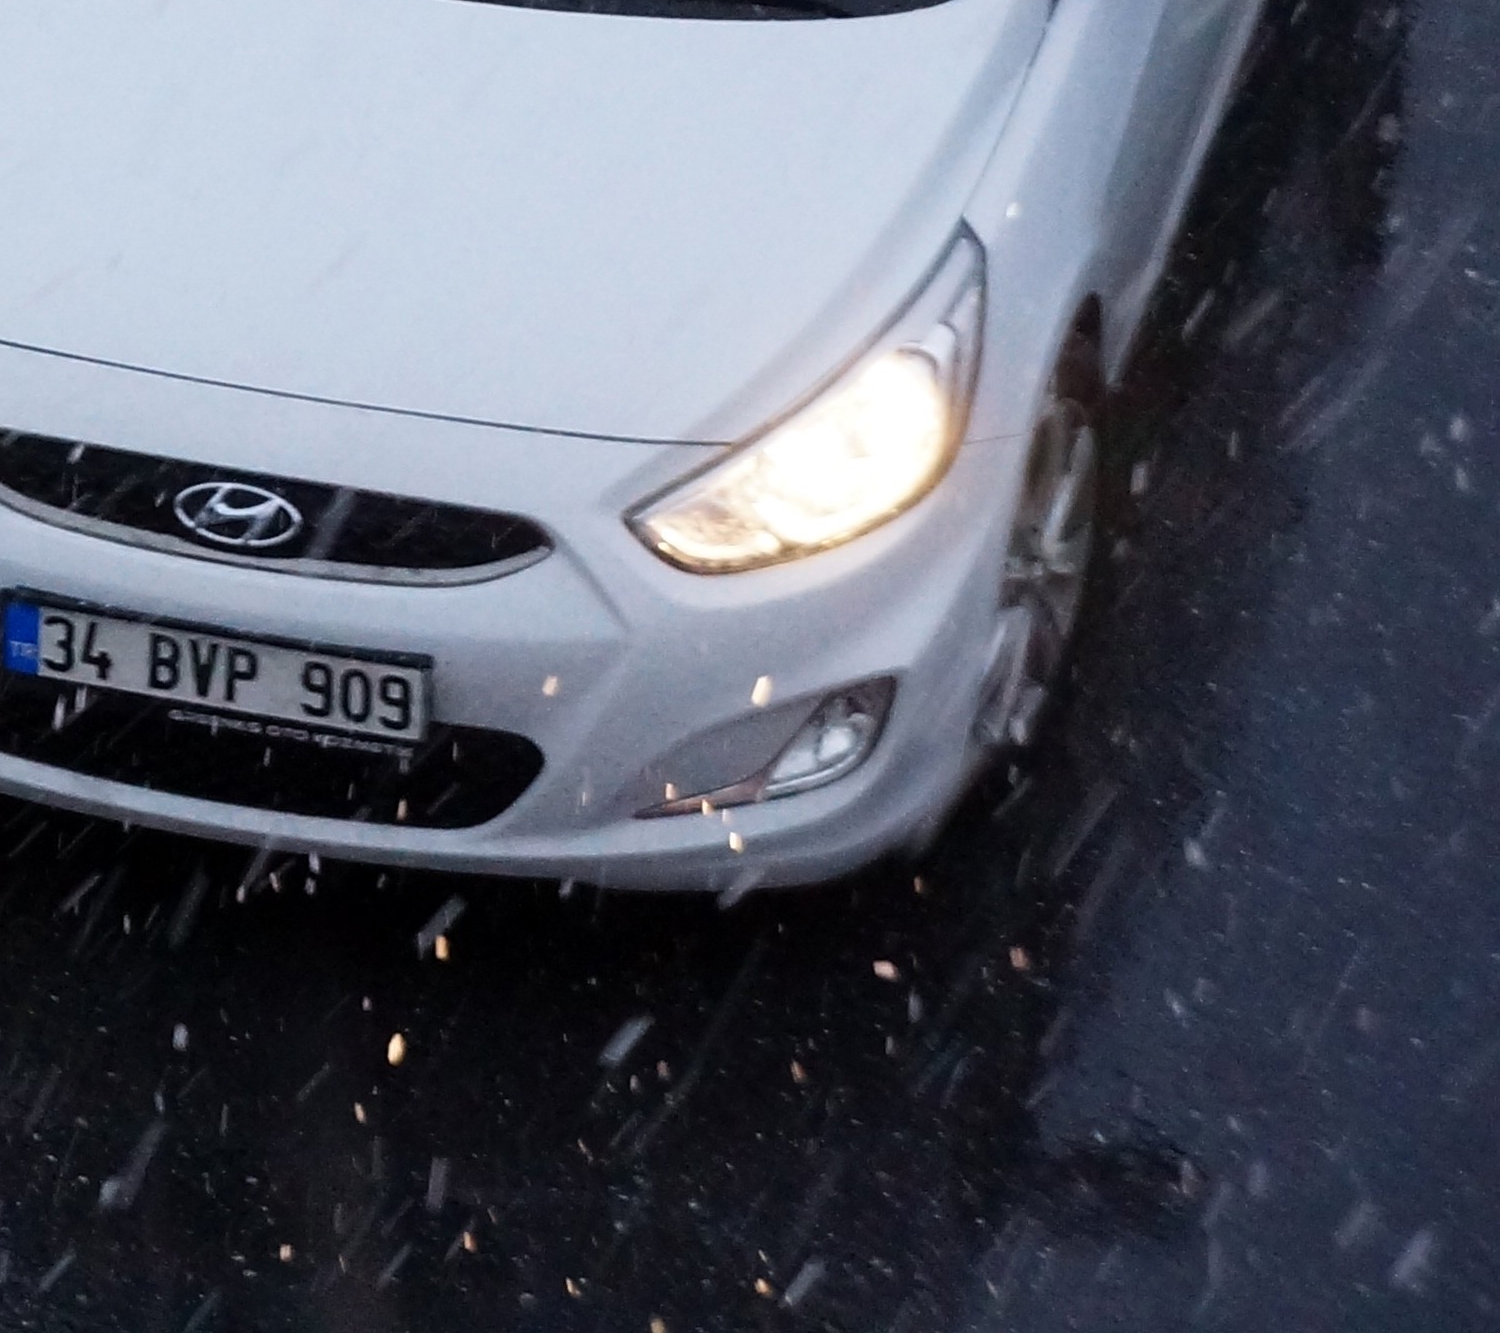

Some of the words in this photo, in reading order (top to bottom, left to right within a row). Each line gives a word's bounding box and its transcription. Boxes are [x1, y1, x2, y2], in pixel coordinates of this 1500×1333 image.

[43, 615, 113, 680] 34
[148, 633, 258, 701] BVP
[300, 660, 411, 730] 909
